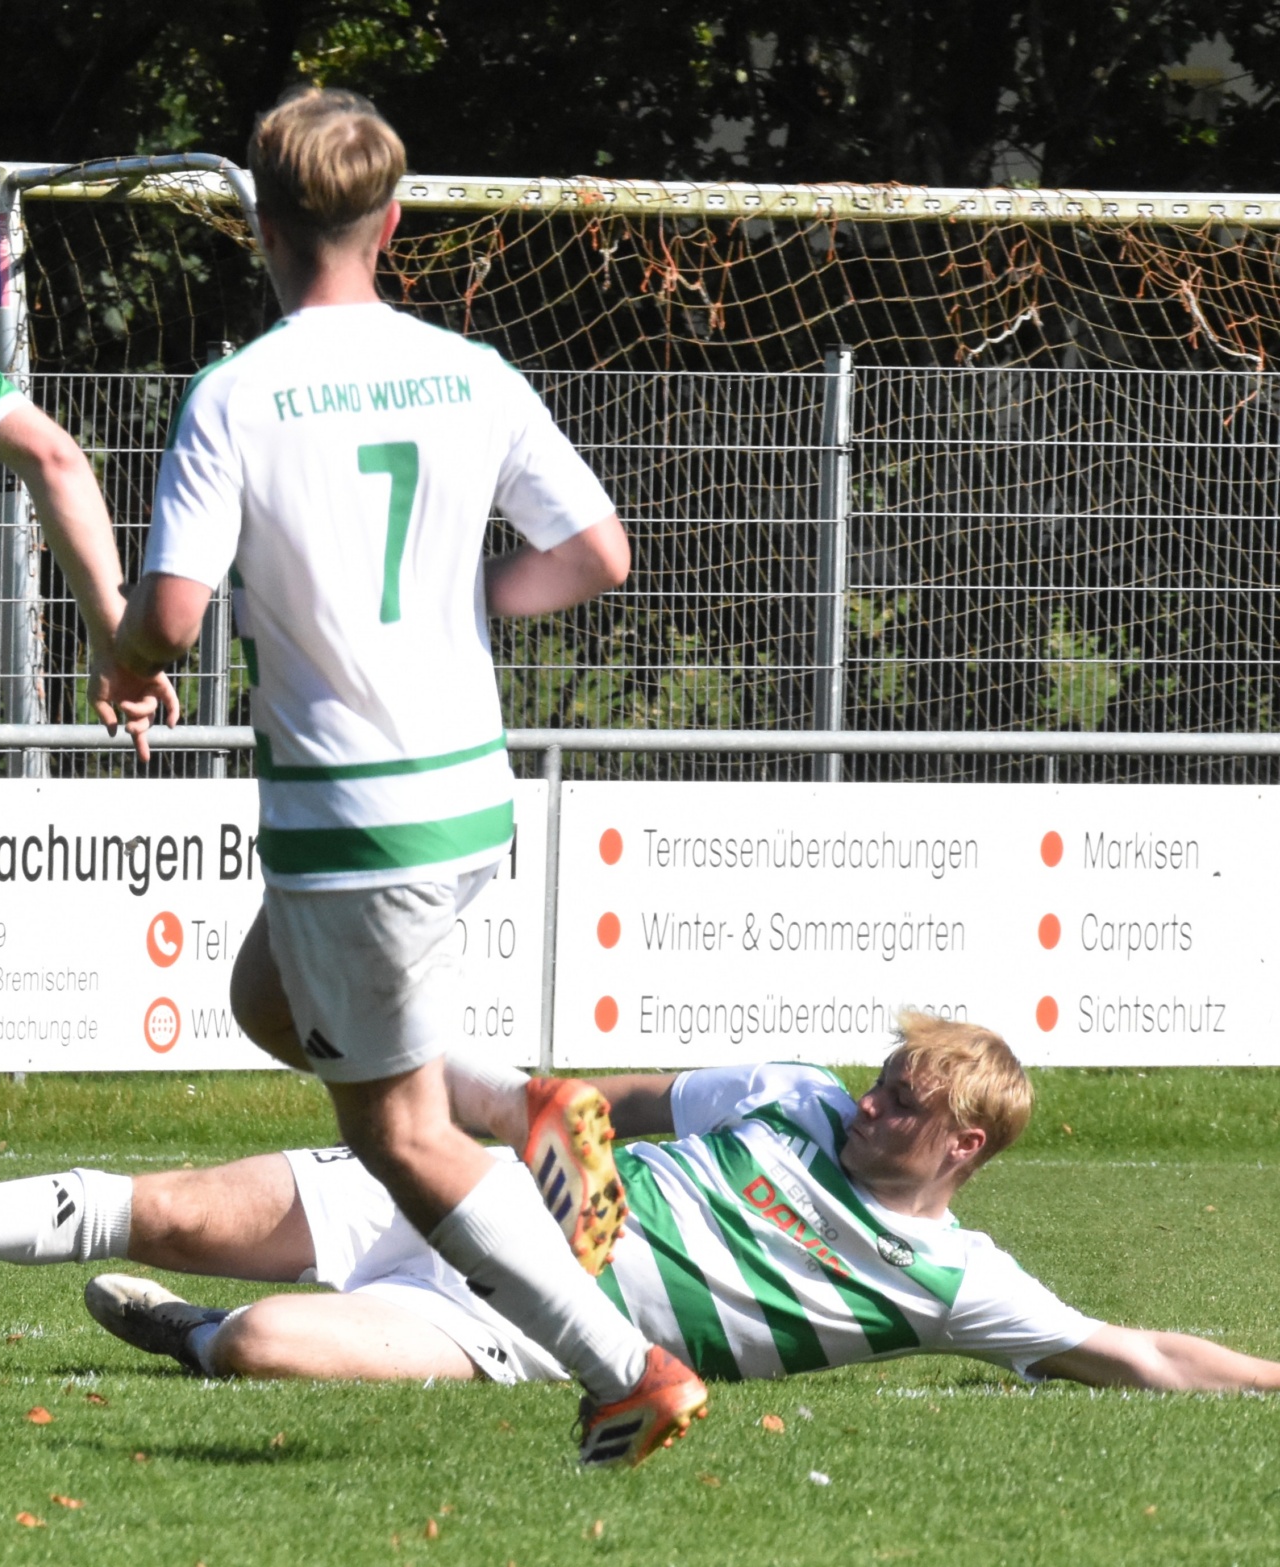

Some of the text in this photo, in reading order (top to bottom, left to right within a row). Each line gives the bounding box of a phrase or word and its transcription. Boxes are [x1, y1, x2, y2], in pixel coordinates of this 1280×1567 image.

[273, 374, 472, 421] FC LAND WURSTEN
[357, 440, 419, 625] 7
[643, 829, 979, 880] Terrassenüberdachungen
[1083, 831, 1200, 870] Markisen
[641, 911, 966, 962] Winter- & Sommergärten
[1080, 912, 1193, 962] Carports
[1077, 994, 1227, 1034] Sichtschutz
[770, 1162, 839, 1243] ELEKTRO
